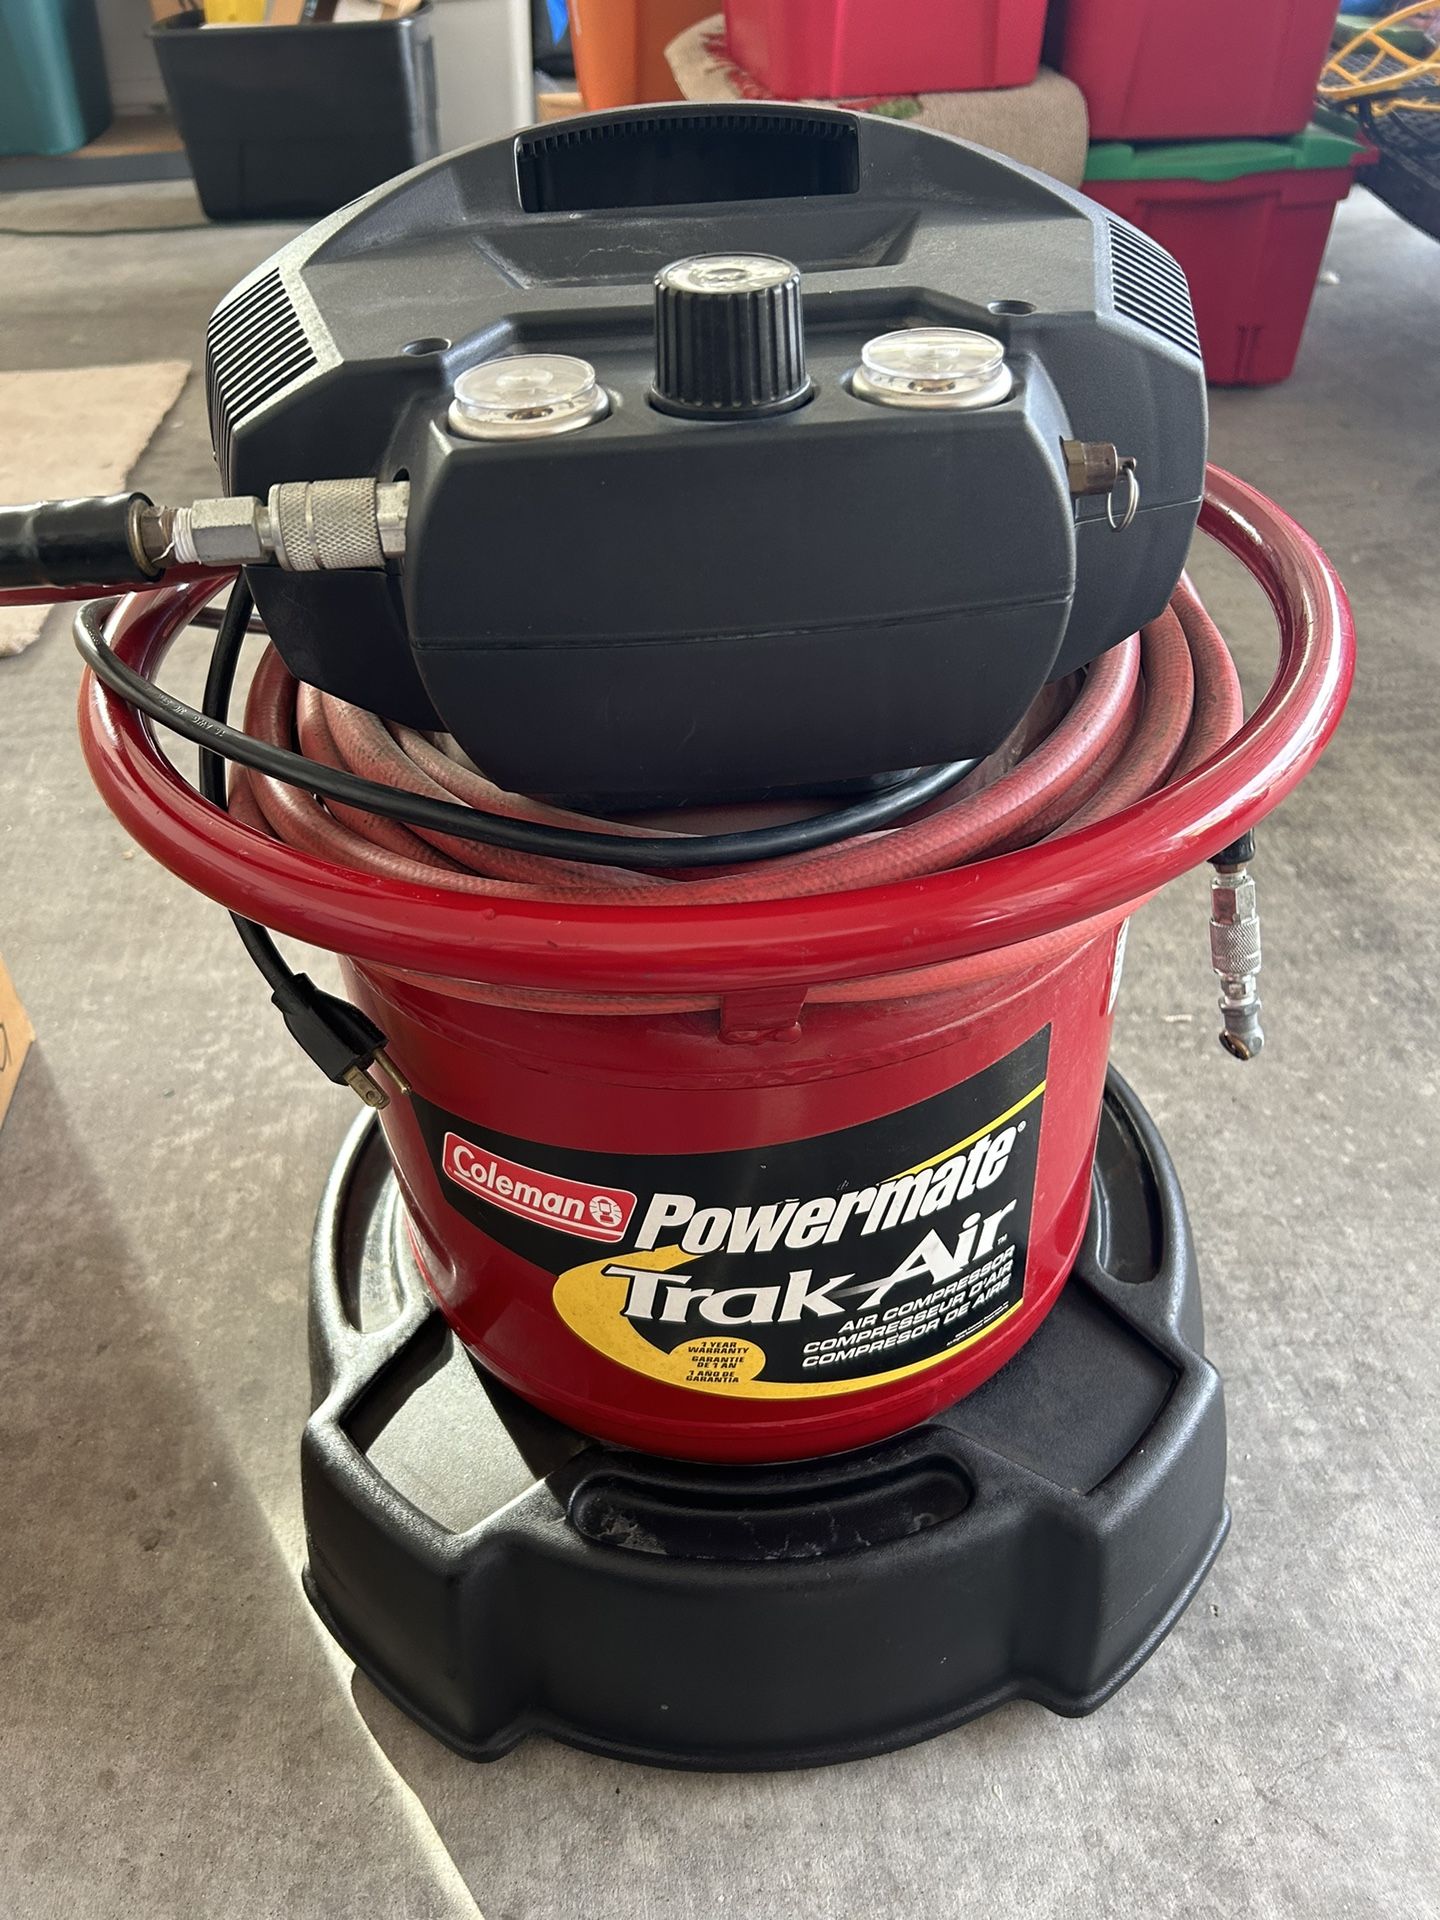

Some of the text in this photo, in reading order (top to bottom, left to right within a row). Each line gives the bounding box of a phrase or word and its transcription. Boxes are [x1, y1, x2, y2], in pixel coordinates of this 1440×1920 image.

[191, 713, 214, 730] AWG
[453, 1145, 586, 1221] Coleman
[634, 1125, 1017, 1254] Powermate
[605, 1266, 856, 1324] Trak
[802, 1319, 941, 1368] COMPRESOR
[943, 1300, 971, 1325] DE
[972, 1272, 1012, 1309] AIRE
[803, 1294, 967, 1354] COMPRESSEUR
[968, 1259, 1014, 1298] D'AIR
[838, 1244, 1016, 1334] AIR COMPRESSOR
